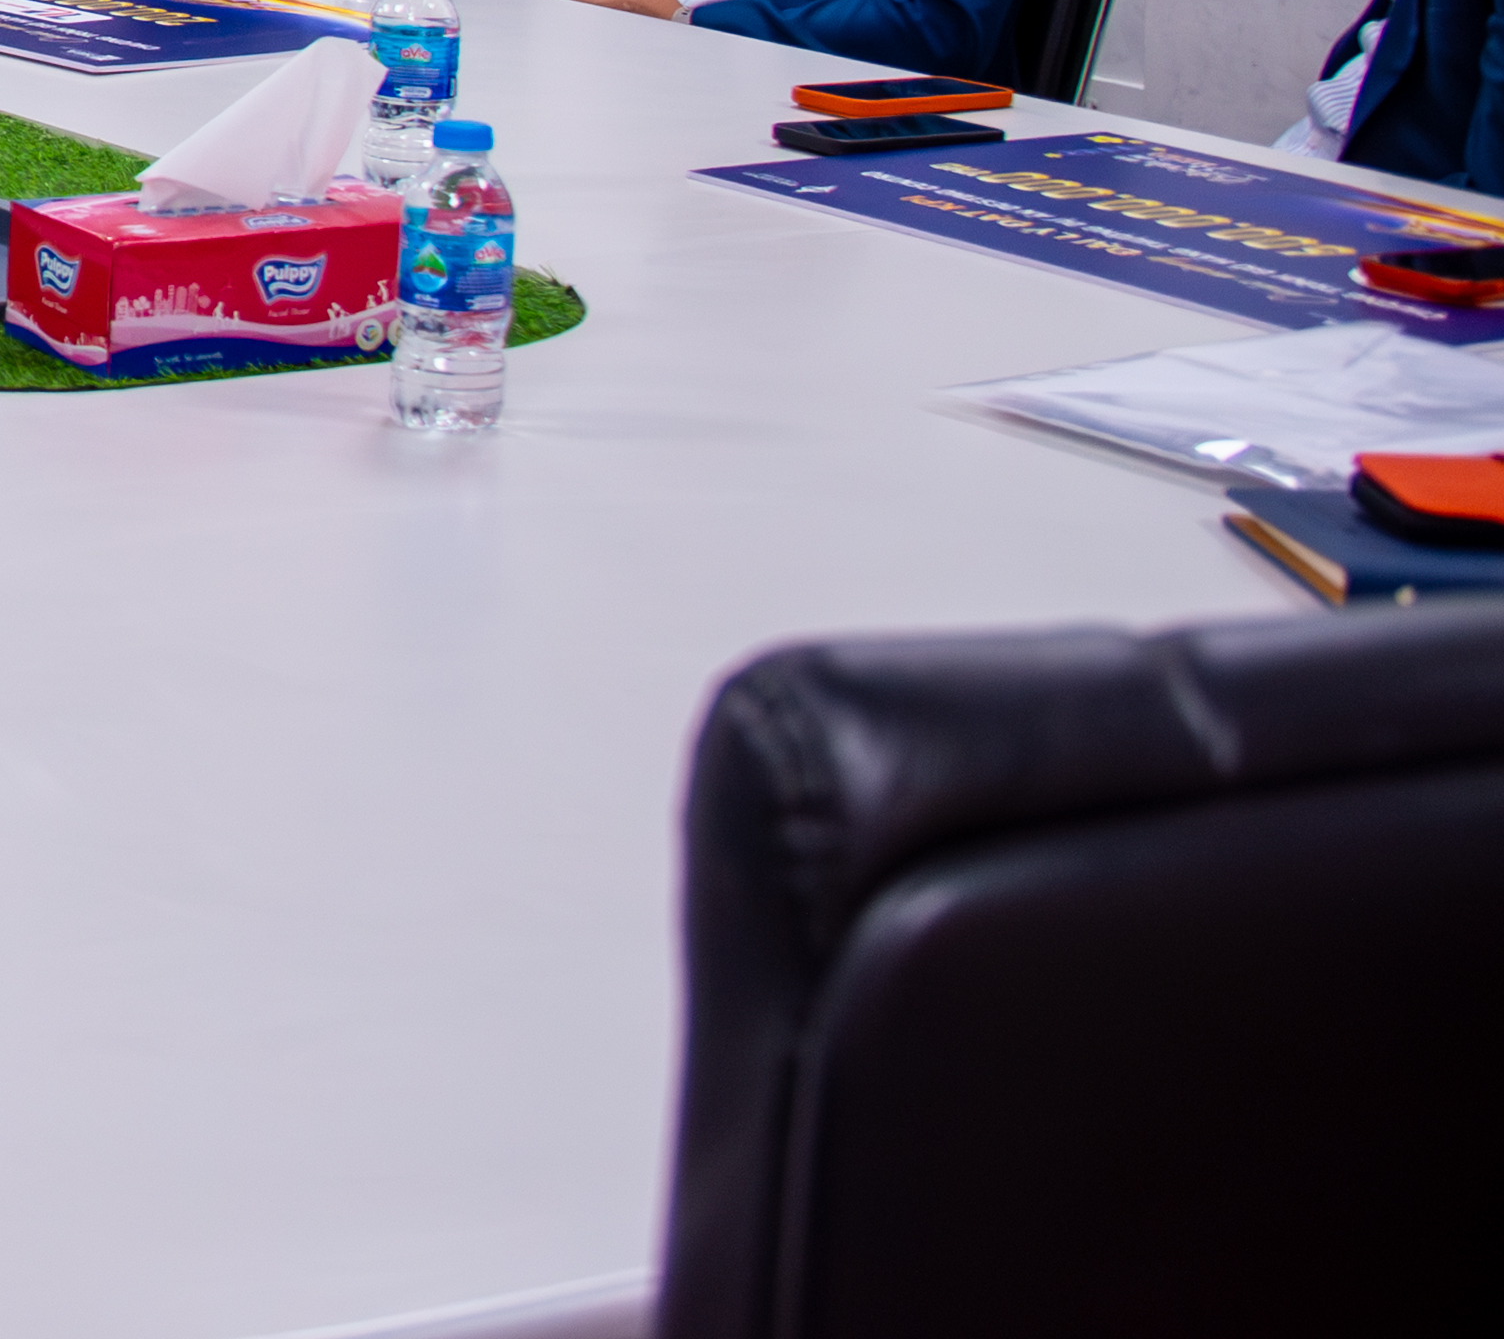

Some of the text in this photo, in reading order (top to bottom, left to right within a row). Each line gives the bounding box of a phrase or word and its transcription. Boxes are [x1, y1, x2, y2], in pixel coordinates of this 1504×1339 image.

[400, 48, 432, 60] laVie
[899, 195, 966, 211] KPI
[40, 252, 76, 281] Pulppy
[263, 263, 320, 284] Pulppy
